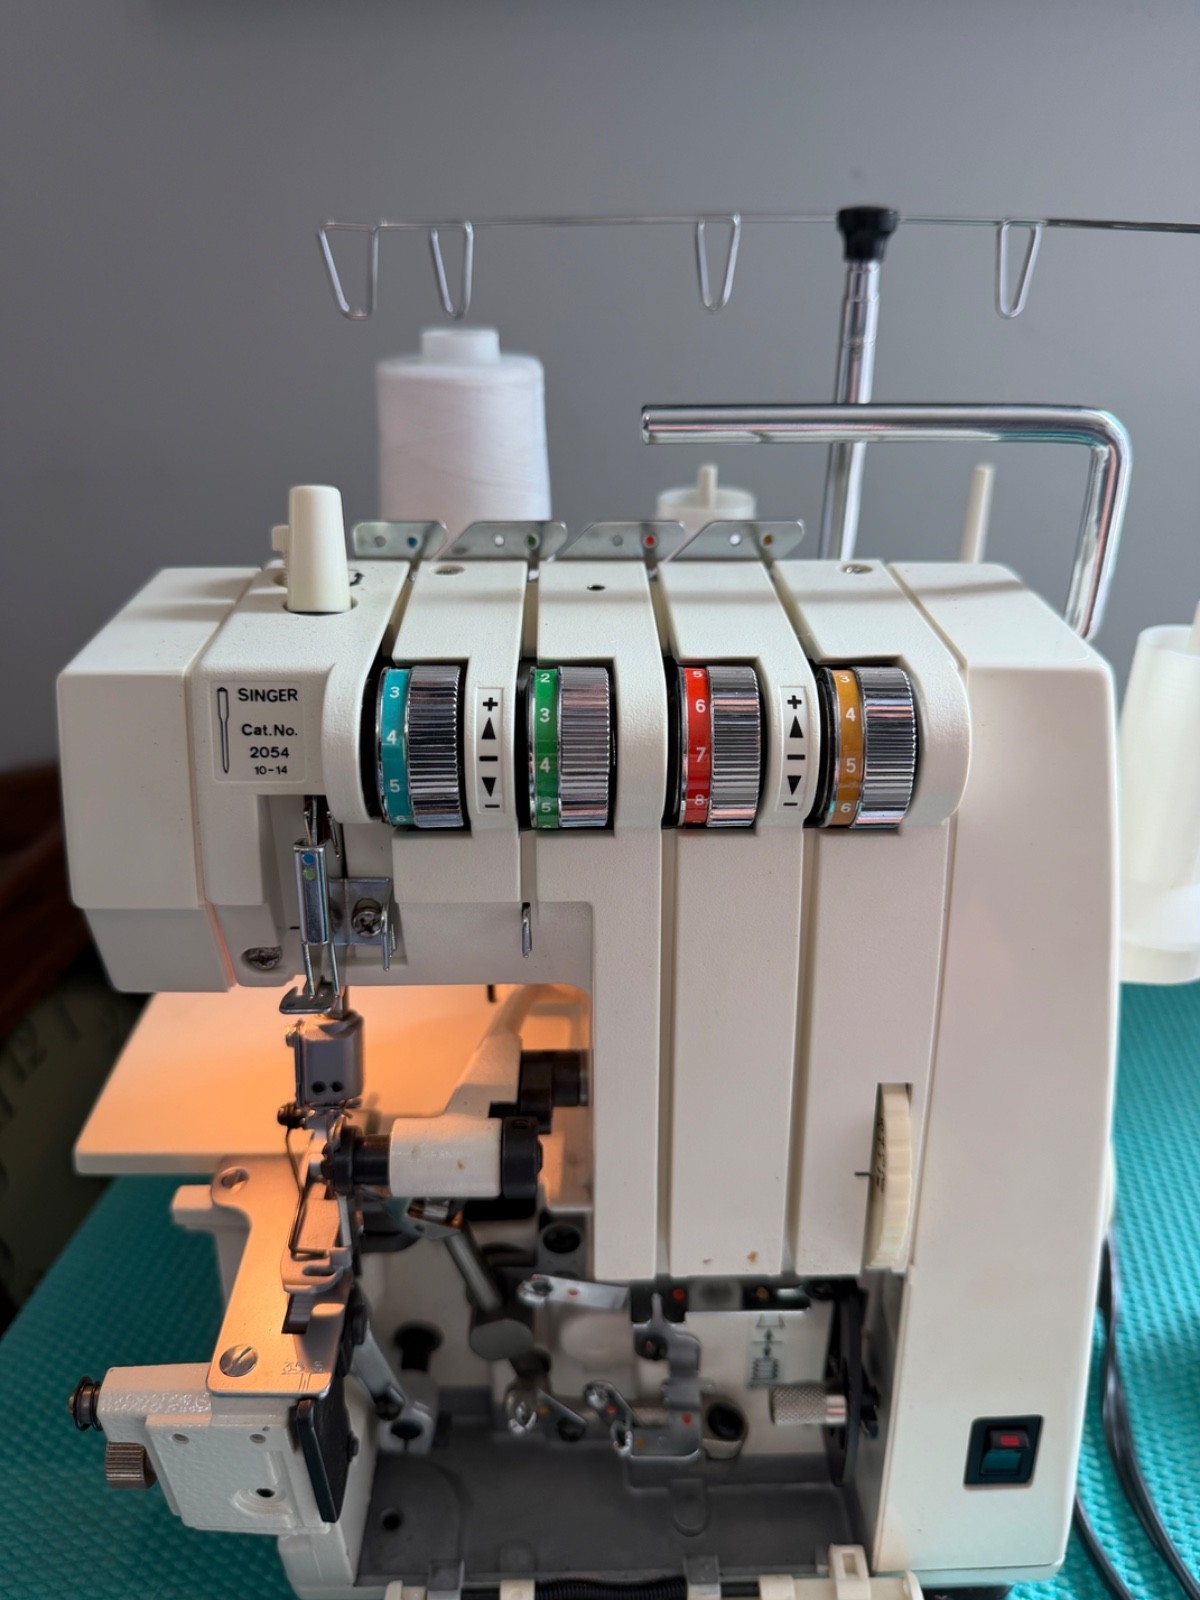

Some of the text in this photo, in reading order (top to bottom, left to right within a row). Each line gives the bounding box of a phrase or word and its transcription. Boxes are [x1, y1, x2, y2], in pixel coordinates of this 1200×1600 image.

[540, 673, 551, 684] 2
[692, 670, 703, 678] 5
[840, 674, 850, 684] 3
[238, 688, 298, 702] SINGER
[389, 686, 400, 699] 3
[695, 699, 706, 713] 6
[539, 708, 551, 722] 3
[845, 707, 856, 722] 4
[386, 730, 397, 745] 4
[250, 746, 289, 758] 2054
[696, 747, 706, 763] 7
[254, 765, 288, 775] 10-14
[539, 757, 551, 773] 4
[846, 757, 857, 774] 5
[389, 779, 400, 793] 5
[694, 793, 705, 806] 8
[541, 802, 551, 812] 5
[840, 802, 851, 813] 6
